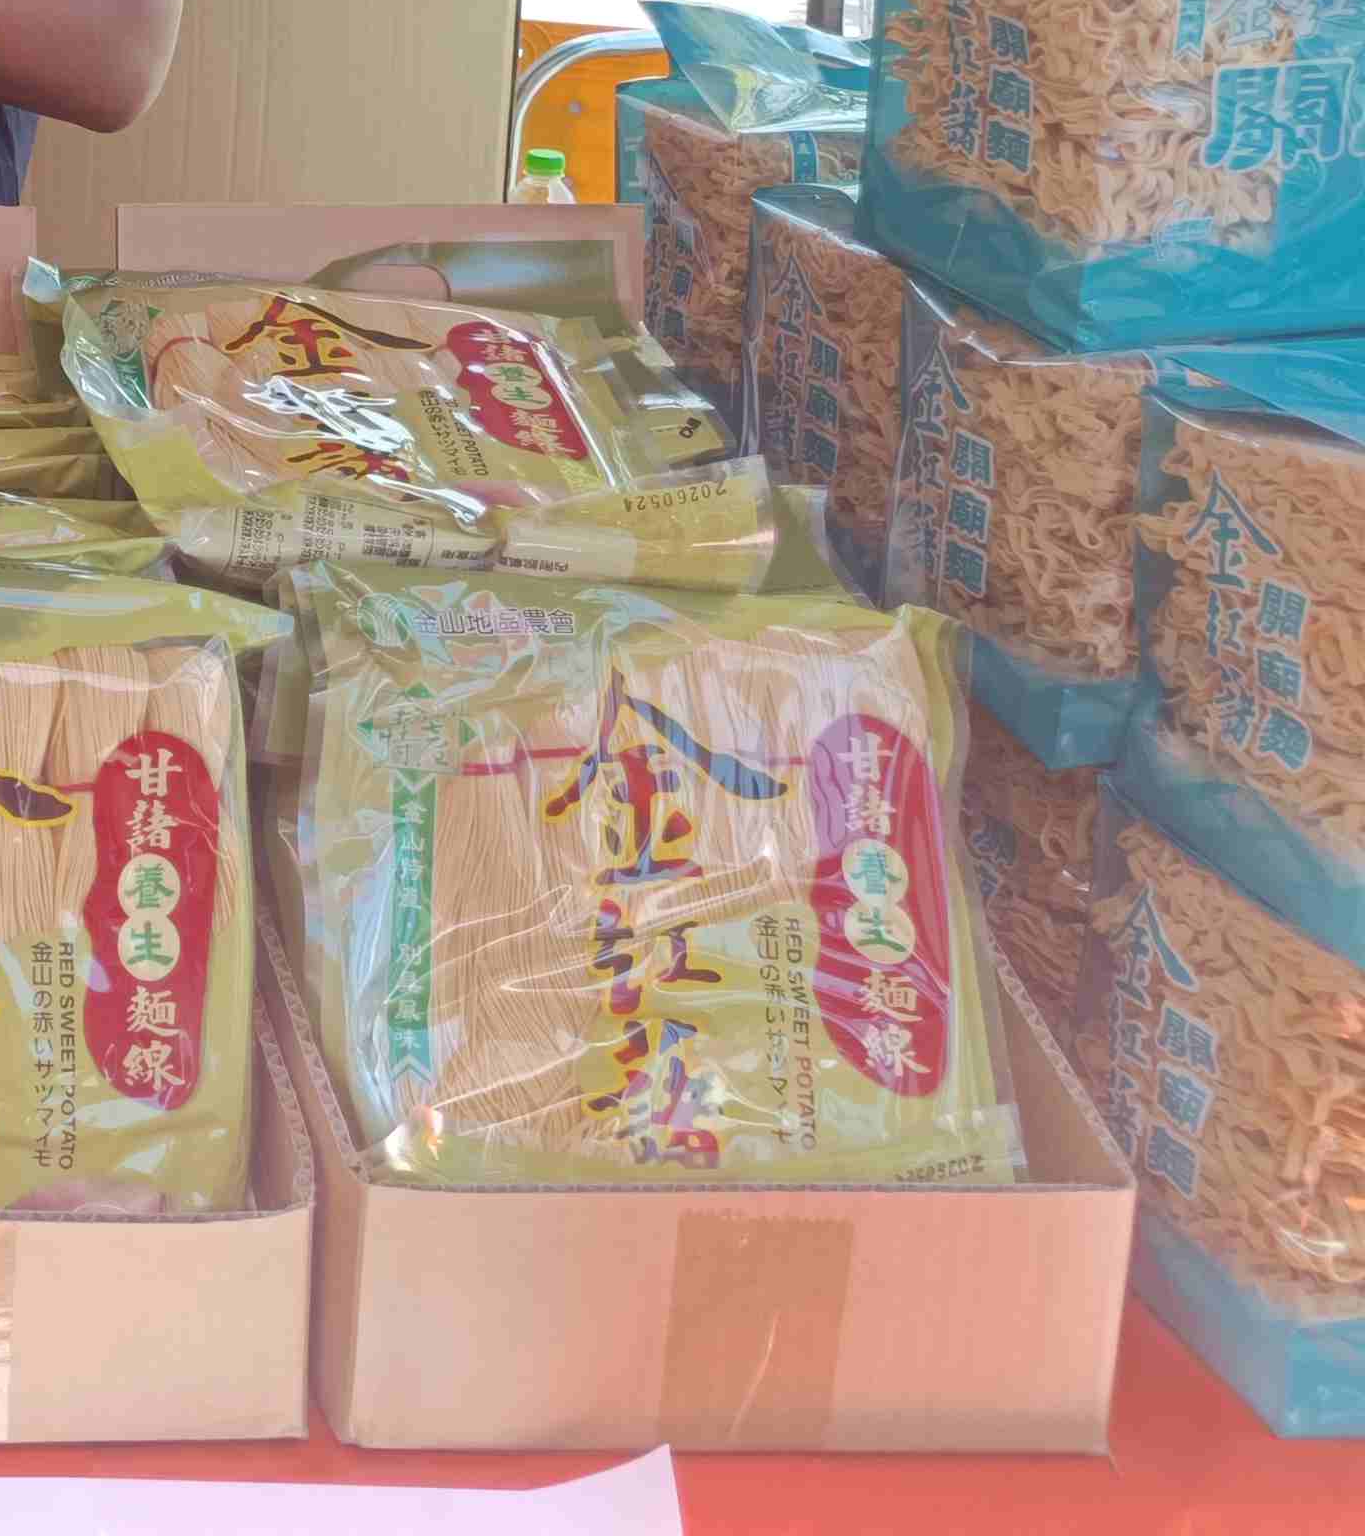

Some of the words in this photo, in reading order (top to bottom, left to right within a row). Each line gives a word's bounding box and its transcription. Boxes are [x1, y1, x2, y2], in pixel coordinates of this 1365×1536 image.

[413, 608, 574, 635] 金山地區農會
[123, 747, 186, 1092] 甘藷養生麵線
[784, 916, 803, 964] RED
[58, 941, 75, 988] RED
[59, 994, 76, 1074] SWEET
[788, 969, 811, 1050] SWEET
[795, 1056, 818, 1152] POTATO
